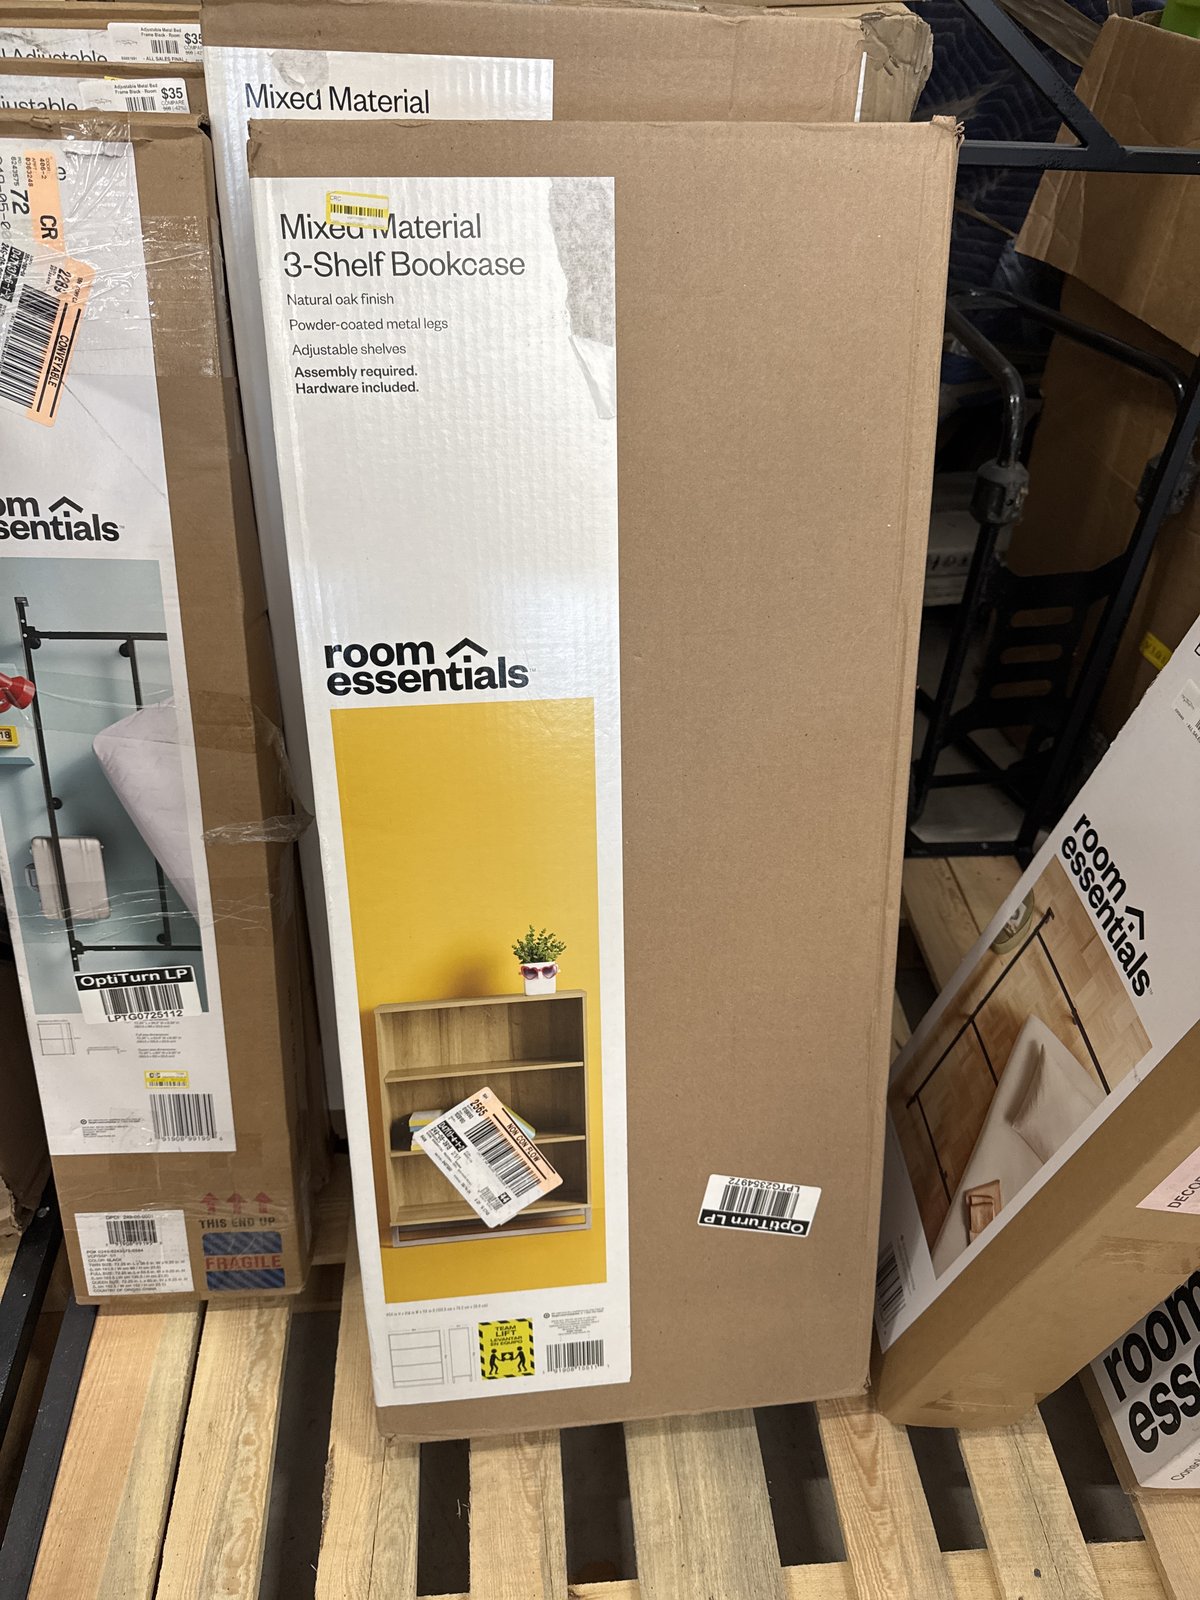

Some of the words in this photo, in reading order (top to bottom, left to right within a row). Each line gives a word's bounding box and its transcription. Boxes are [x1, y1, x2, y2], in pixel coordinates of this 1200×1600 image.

[161, 87, 183, 100] $35
[244, 83, 322, 111] Mixed
[329, 85, 430, 114] Material
[10, 189, 30, 215] 72
[40, 215, 58, 240] CR
[372, 213, 481, 240] Material
[284, 251, 386, 278] 3-Shelf
[391, 251, 525, 277] Bookcase
[286, 293, 333, 306] Natural
[335, 293, 359, 306] oak
[360, 292, 394, 306] finish
[289, 317, 384, 332] Powder-coated
[386, 317, 421, 331] metal
[423, 317, 449, 332] legs
[292, 342, 358, 359] Adjustable
[360, 342, 407, 356] shelves
[47, 334, 70, 388] CONVEYABLE
[294, 365, 358, 380] Assembly
[360, 365, 418, 380] required.
[295, 381, 360, 395] Hardware
[361, 381, 420, 394] included.
[0, 496, 40, 517] m
[324, 641, 435, 669] room
[326, 655, 530, 696] essentials
[1072, 812, 1127, 904] room
[1060, 834, 1151, 998] essentials
[80, 971, 161, 988] OptiTurn
[164, 968, 189, 980] LP
[107, 1010, 184, 1023] LPTG0725112
[470, 1099, 488, 1118] 2565
[506, 1122, 519, 1136] NON
[516, 1134, 529, 1150] CON
[524, 1146, 541, 1163] FLOW
[728, 1177, 801, 1193] LPTG2354972
[199, 1218, 227, 1229] THIS
[231, 1217, 255, 1228] END
[258, 1216, 276, 1226] UP
[703, 1213, 727, 1225] LP
[730, 1216, 804, 1234] OptiTurn
[205, 1255, 282, 1270] FRAGILE
[495, 1324, 517, 1332] TEAM
